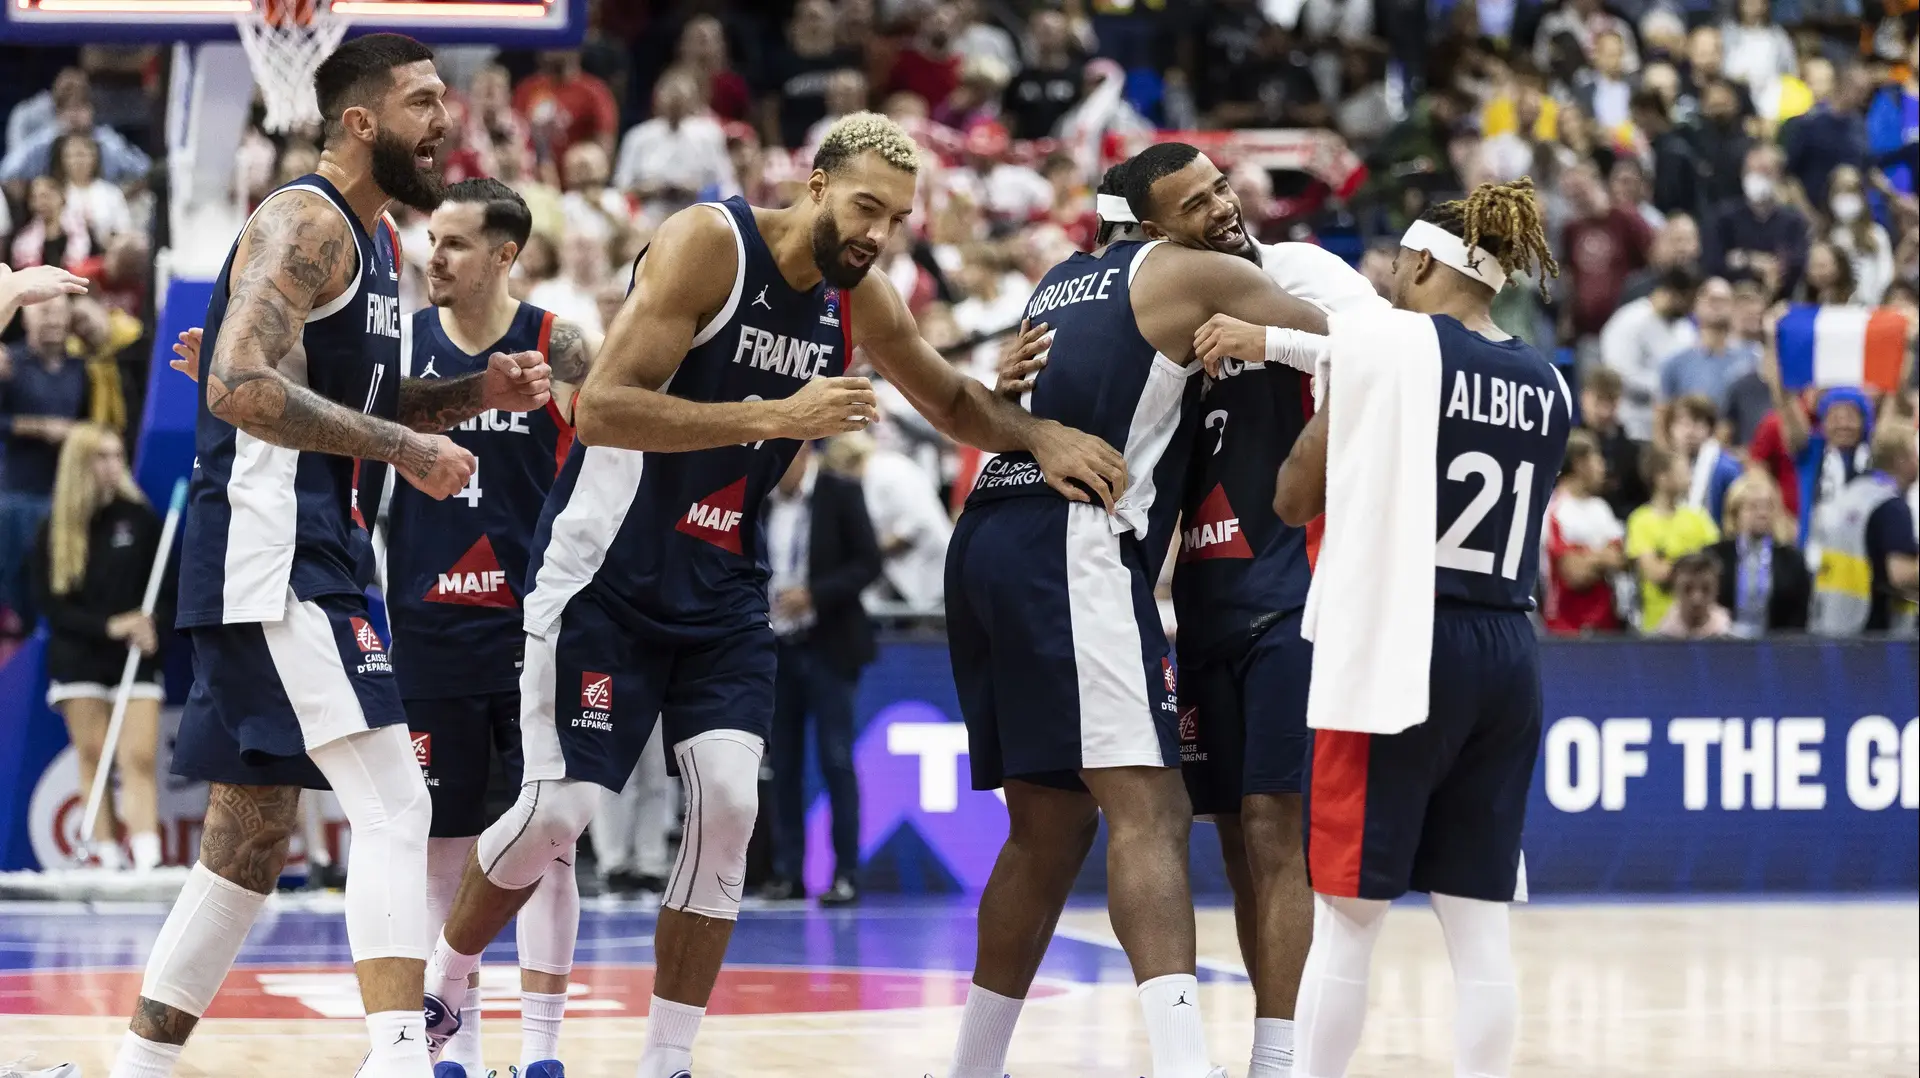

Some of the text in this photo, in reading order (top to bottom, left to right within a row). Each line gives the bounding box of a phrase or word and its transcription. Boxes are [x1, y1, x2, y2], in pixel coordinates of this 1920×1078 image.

[732, 324, 834, 380] FRANCE
[1446, 370, 1555, 436] ALBICY
[686, 502, 743, 532] MAIF
[1184, 517, 1239, 552] MAIF
[1435, 451, 1535, 581] 21
[438, 570, 505, 594] MAIF
[582, 710, 610, 721] CAISSE
[1545, 716, 1652, 813] OF
[1667, 716, 1827, 811] THE
